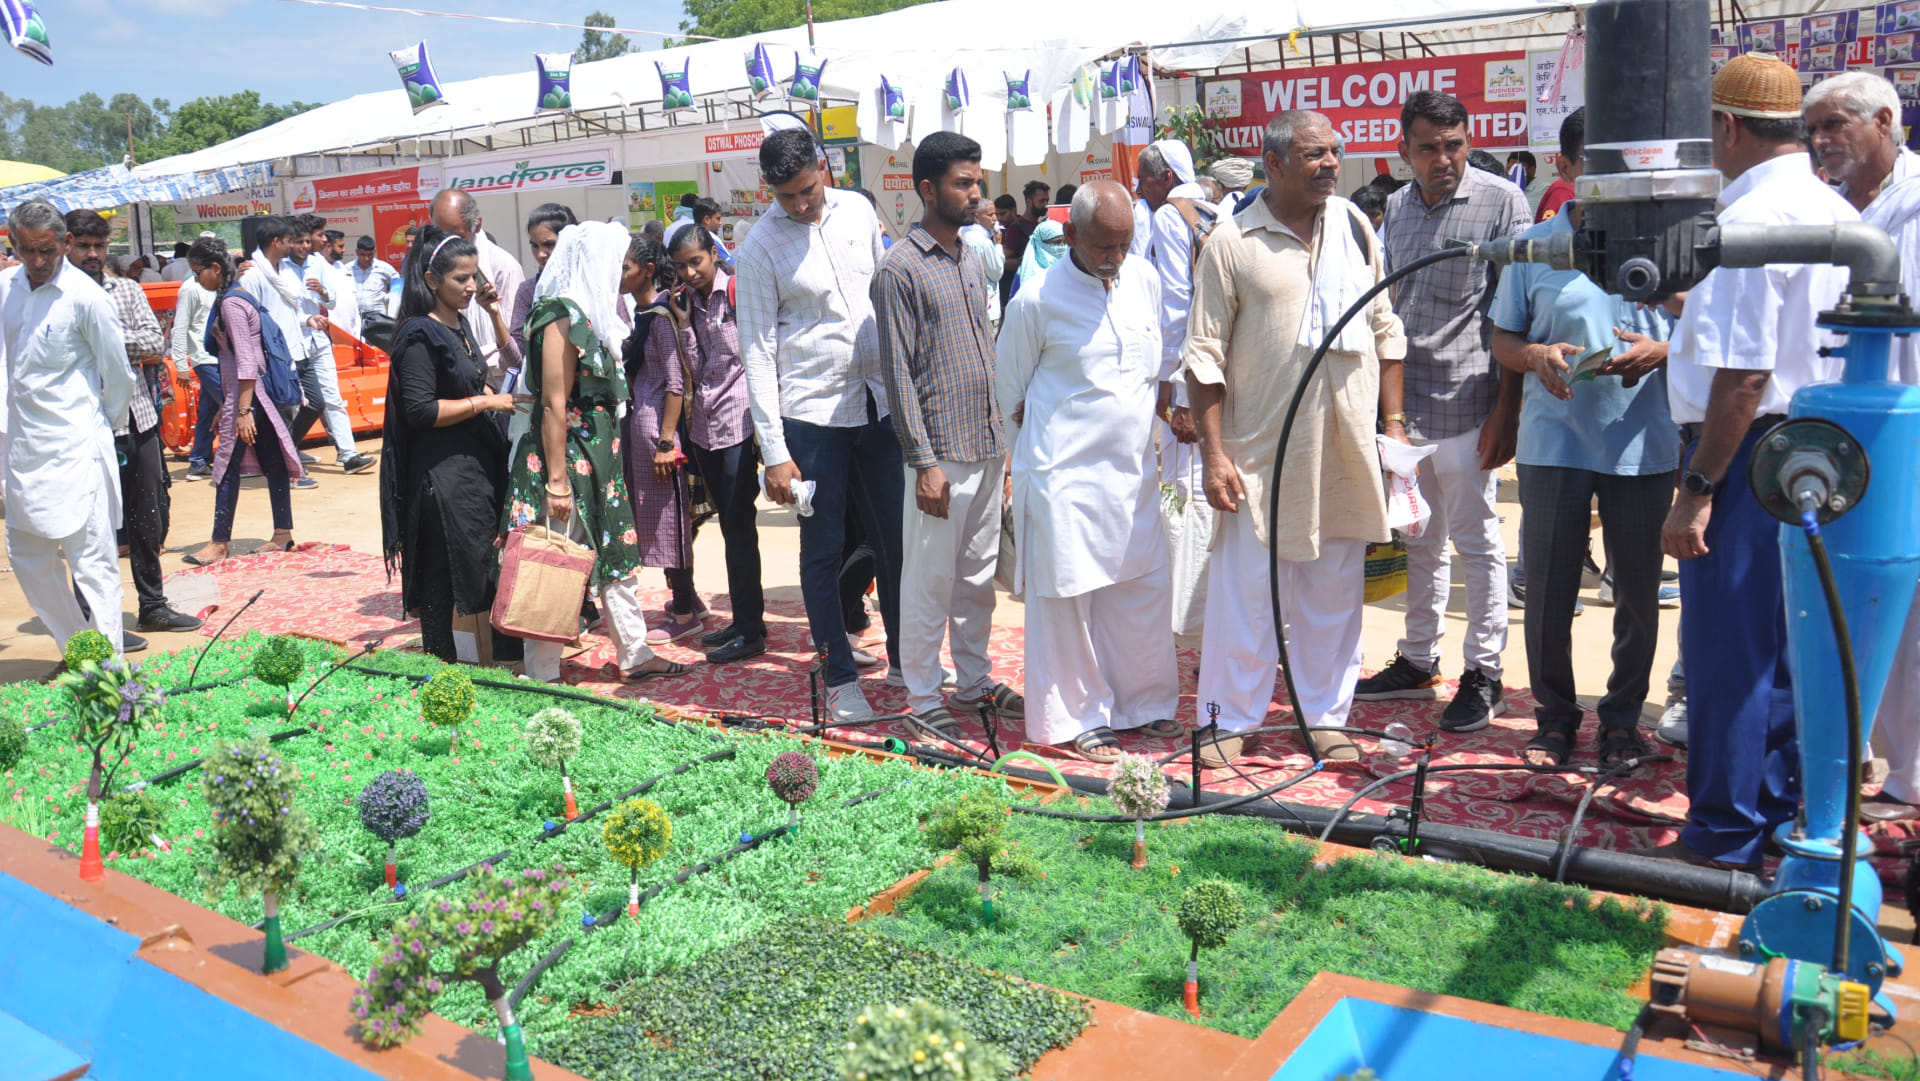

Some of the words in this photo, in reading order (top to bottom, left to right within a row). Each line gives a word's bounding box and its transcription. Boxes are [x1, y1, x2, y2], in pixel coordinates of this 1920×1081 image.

[1261, 68, 1457, 112] WELCOME
[708, 135, 733, 150] OSTWAL
[734, 132, 765, 148] PHOSCHE
[1208, 125, 1264, 148] NUZIV
[1340, 118, 1401, 144] SEED
[1468, 112, 1528, 138] ITED
[452, 162, 606, 190] landforce
[197, 203, 248, 218] Welcomes
[251, 200, 272, 214] You
